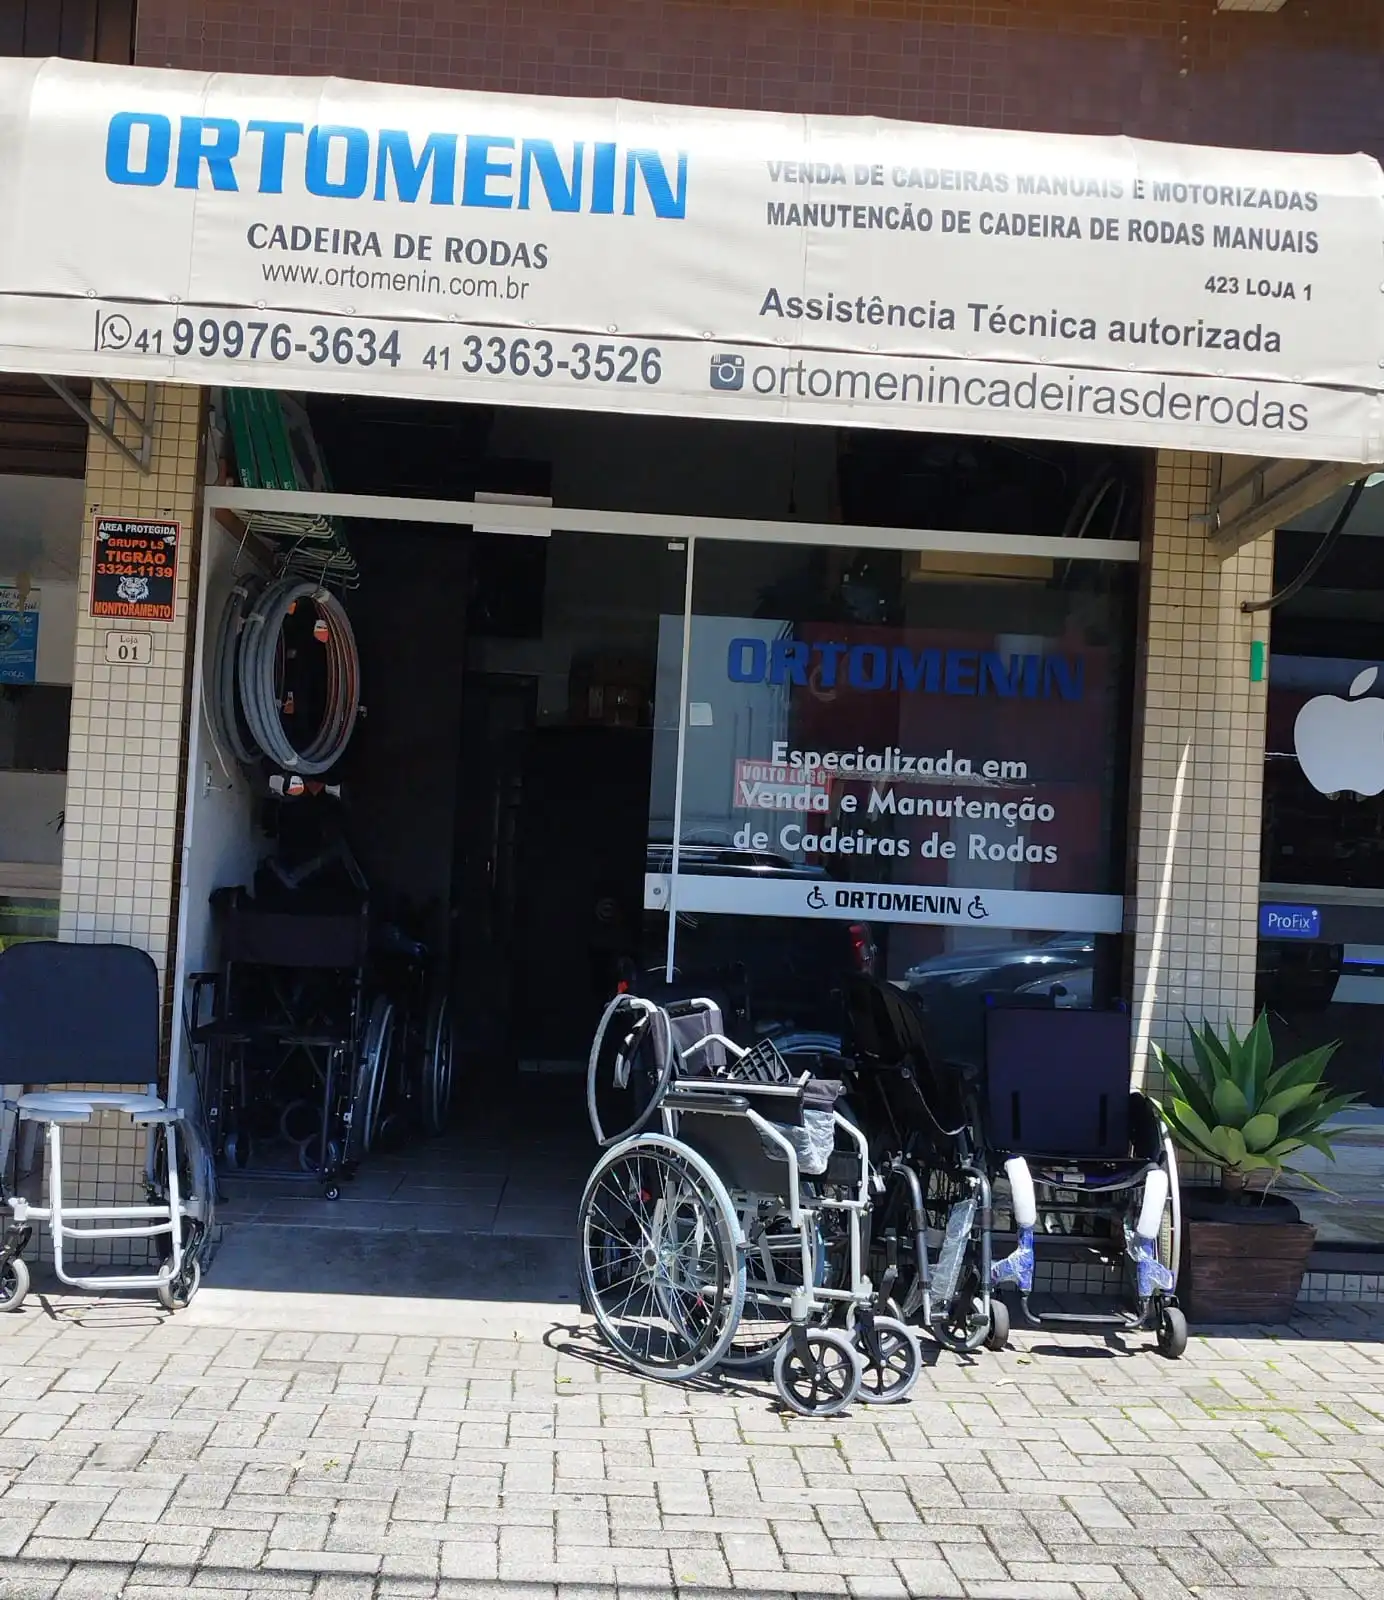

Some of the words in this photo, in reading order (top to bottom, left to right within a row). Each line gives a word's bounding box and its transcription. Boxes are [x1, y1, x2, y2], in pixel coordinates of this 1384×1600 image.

[105, 111, 688, 220] ORTOMENIN
[767, 160, 847, 185] VENDA
[854, 164, 884, 186] DE
[891, 166, 1009, 194] CADEIRAS
[1016, 173, 1124, 199] MANUAIS
[1133, 179, 1145, 200] E
[1152, 181, 1319, 212] MOTORIZADAS
[247, 222, 382, 258] CADEIRA
[393, 232, 433, 261] DE
[444, 236, 549, 269] RODAS
[767, 201, 933, 232] MANUTENCÃO
[941, 209, 971, 234] DE
[979, 212, 1082, 240] CADEIRA
[1090, 217, 1120, 241] DE
[1127, 219, 1205, 247] RODAS
[1213, 224, 1319, 254] MANUAIS
[262, 263, 530, 300] www.ortomenin.com.br
[1205, 276, 1240, 294] 423
[1245, 278, 1296, 300] LOJA
[1303, 284, 1312, 301] 1
[759, 287, 956, 331] Assistência
[967, 302, 1097, 340] Técnica
[1108, 316, 1281, 353] autorizada
[134, 328, 162, 354] 41
[173, 317, 401, 367] 99976-3634
[422, 345, 449, 371] 41
[462, 335, 662, 384] 3363-3526
[752, 359, 1309, 431] ortomenincadeirasderodas
[108, 538, 147, 548] GRUPO
[125, 523, 175, 535] PROTEGIDA
[97, 564, 173, 577] 3324-1139
[106, 550, 166, 563] TIGRÃO
[95, 602, 171, 617] MONITORAMENTO
[118, 645, 139, 661] 01
[728, 638, 1084, 700] ORTOMENIN
[771, 740, 972, 778] Especializada
[982, 759, 1028, 780] em
[739, 780, 830, 812] Venda
[840, 794, 858, 813] e
[867, 787, 1055, 828] Manutenção
[733, 822, 768, 849] de
[779, 824, 910, 857] Cadeiras
[921, 831, 957, 859] de
[968, 833, 1058, 864] Rodas
[835, 889, 962, 916] ORTOMENIN
[1268, 912, 1310, 928] ProFix
